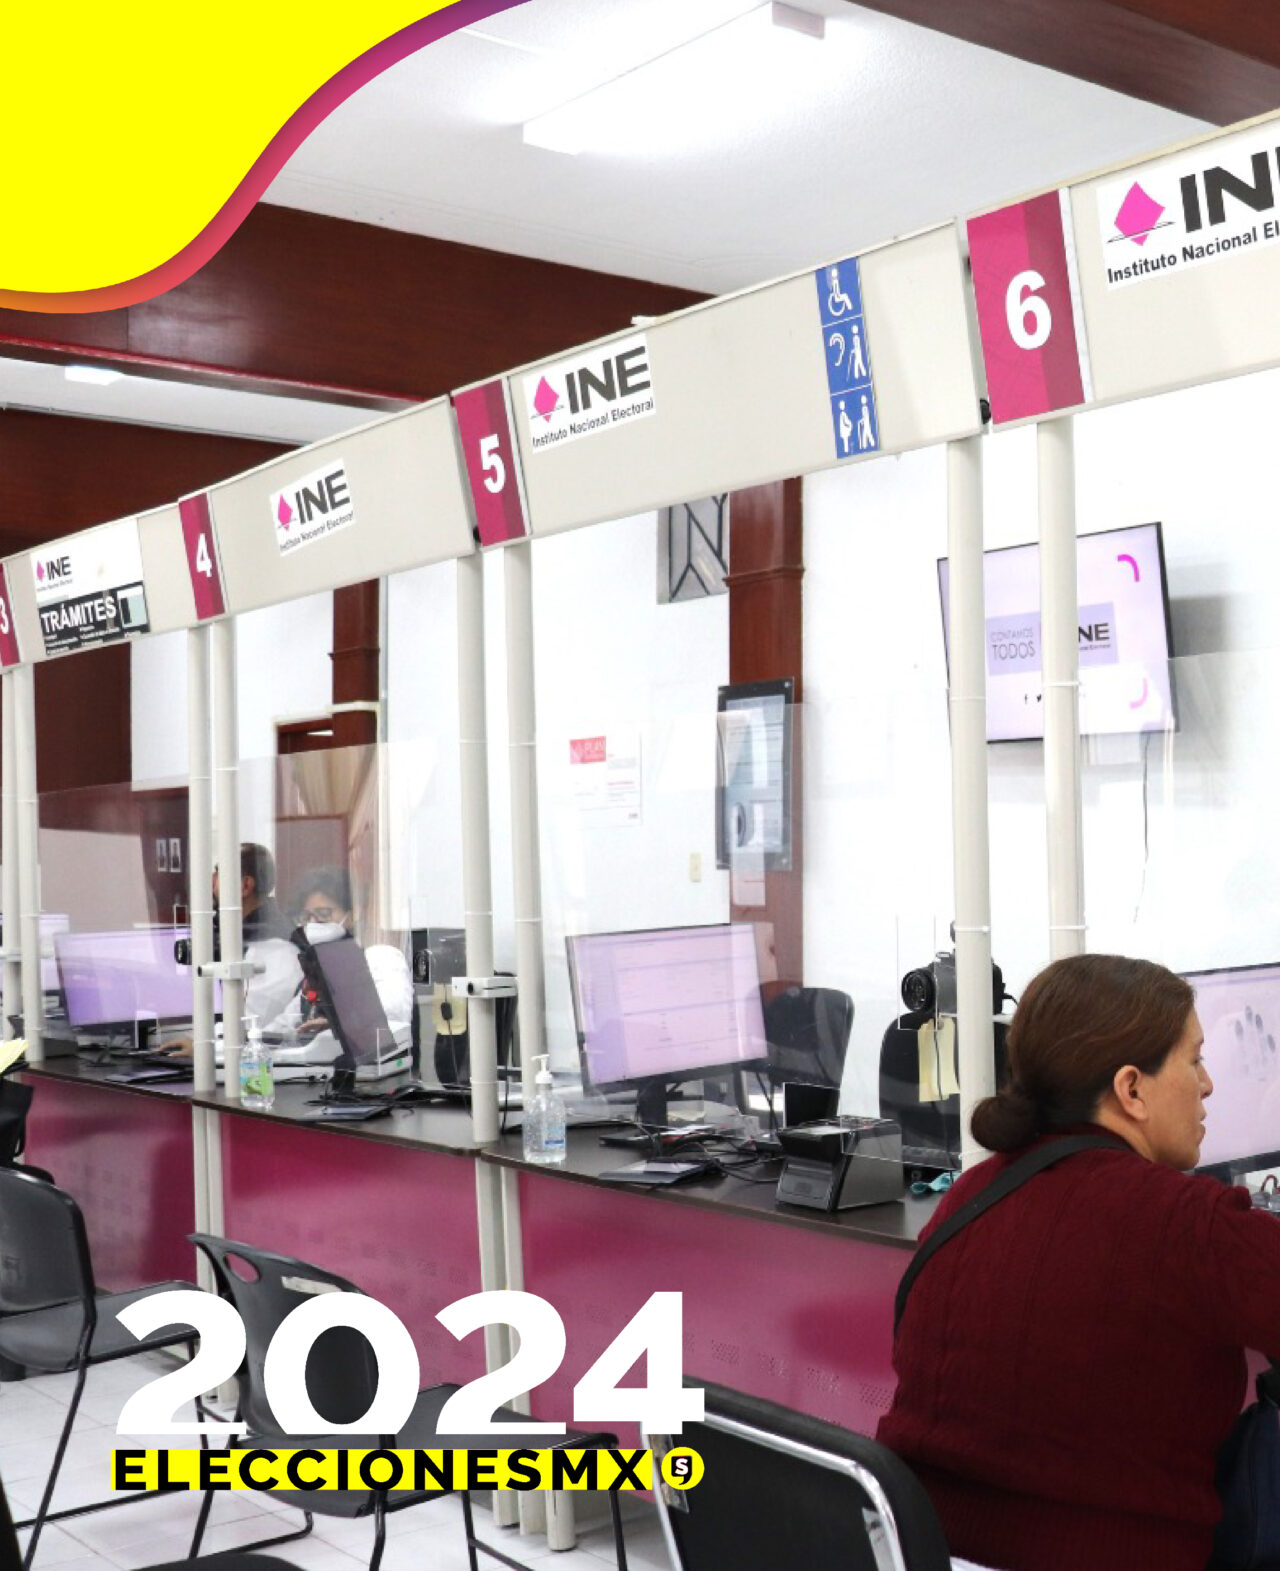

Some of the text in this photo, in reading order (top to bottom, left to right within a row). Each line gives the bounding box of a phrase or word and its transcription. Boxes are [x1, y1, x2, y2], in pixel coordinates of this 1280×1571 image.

[1107, 254, 1177, 283] Instituto
[1182, 227, 1257, 262] Nacional
[1005, 269, 1052, 350] 6
[565, 346, 650, 414] INE
[532, 399, 654, 447] Instituto Nacional Electoral
[480, 434, 506, 493] 5
[295, 469, 351, 525] INE
[46, 555, 72, 580] INE
[196, 533, 212, 577] 4
[41, 596, 117, 634] TRÁMITES
[1078, 622, 1110, 643] NE
[992, 641, 1036, 660] TODOS
